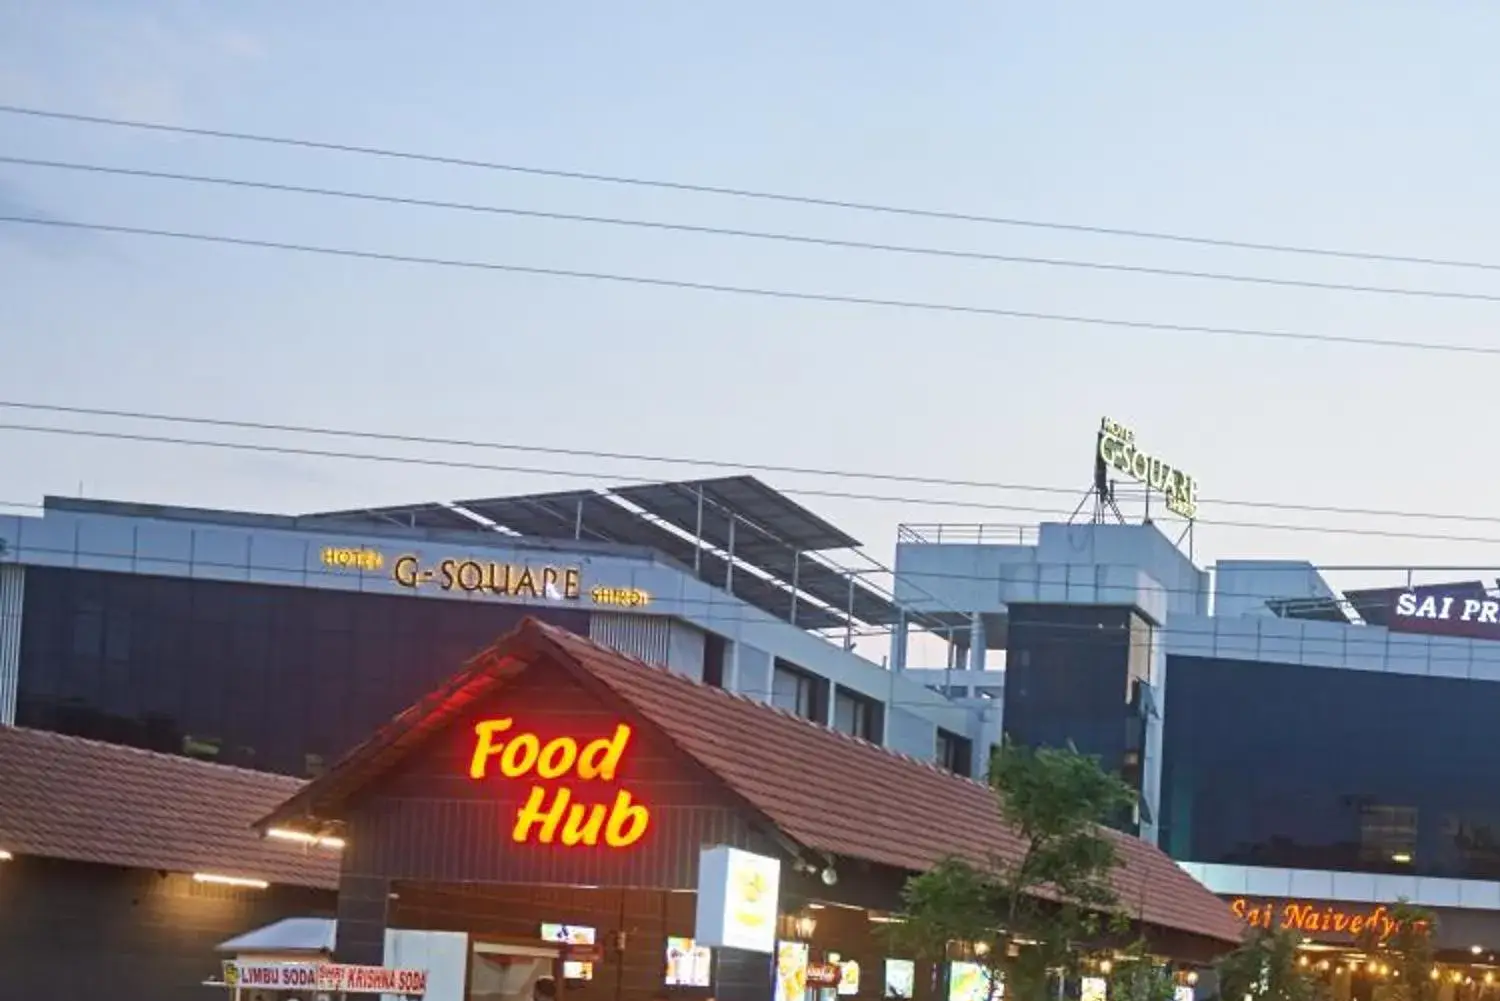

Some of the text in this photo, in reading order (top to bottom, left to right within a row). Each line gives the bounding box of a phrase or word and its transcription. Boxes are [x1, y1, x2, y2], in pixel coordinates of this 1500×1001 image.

[394, 556, 581, 601] G-SQUARE
[1396, 592, 1455, 620] SAI
[469, 717, 632, 781] Food
[511, 785, 650, 848] Hub
[240, 966, 316, 987] LIMBU SODA
